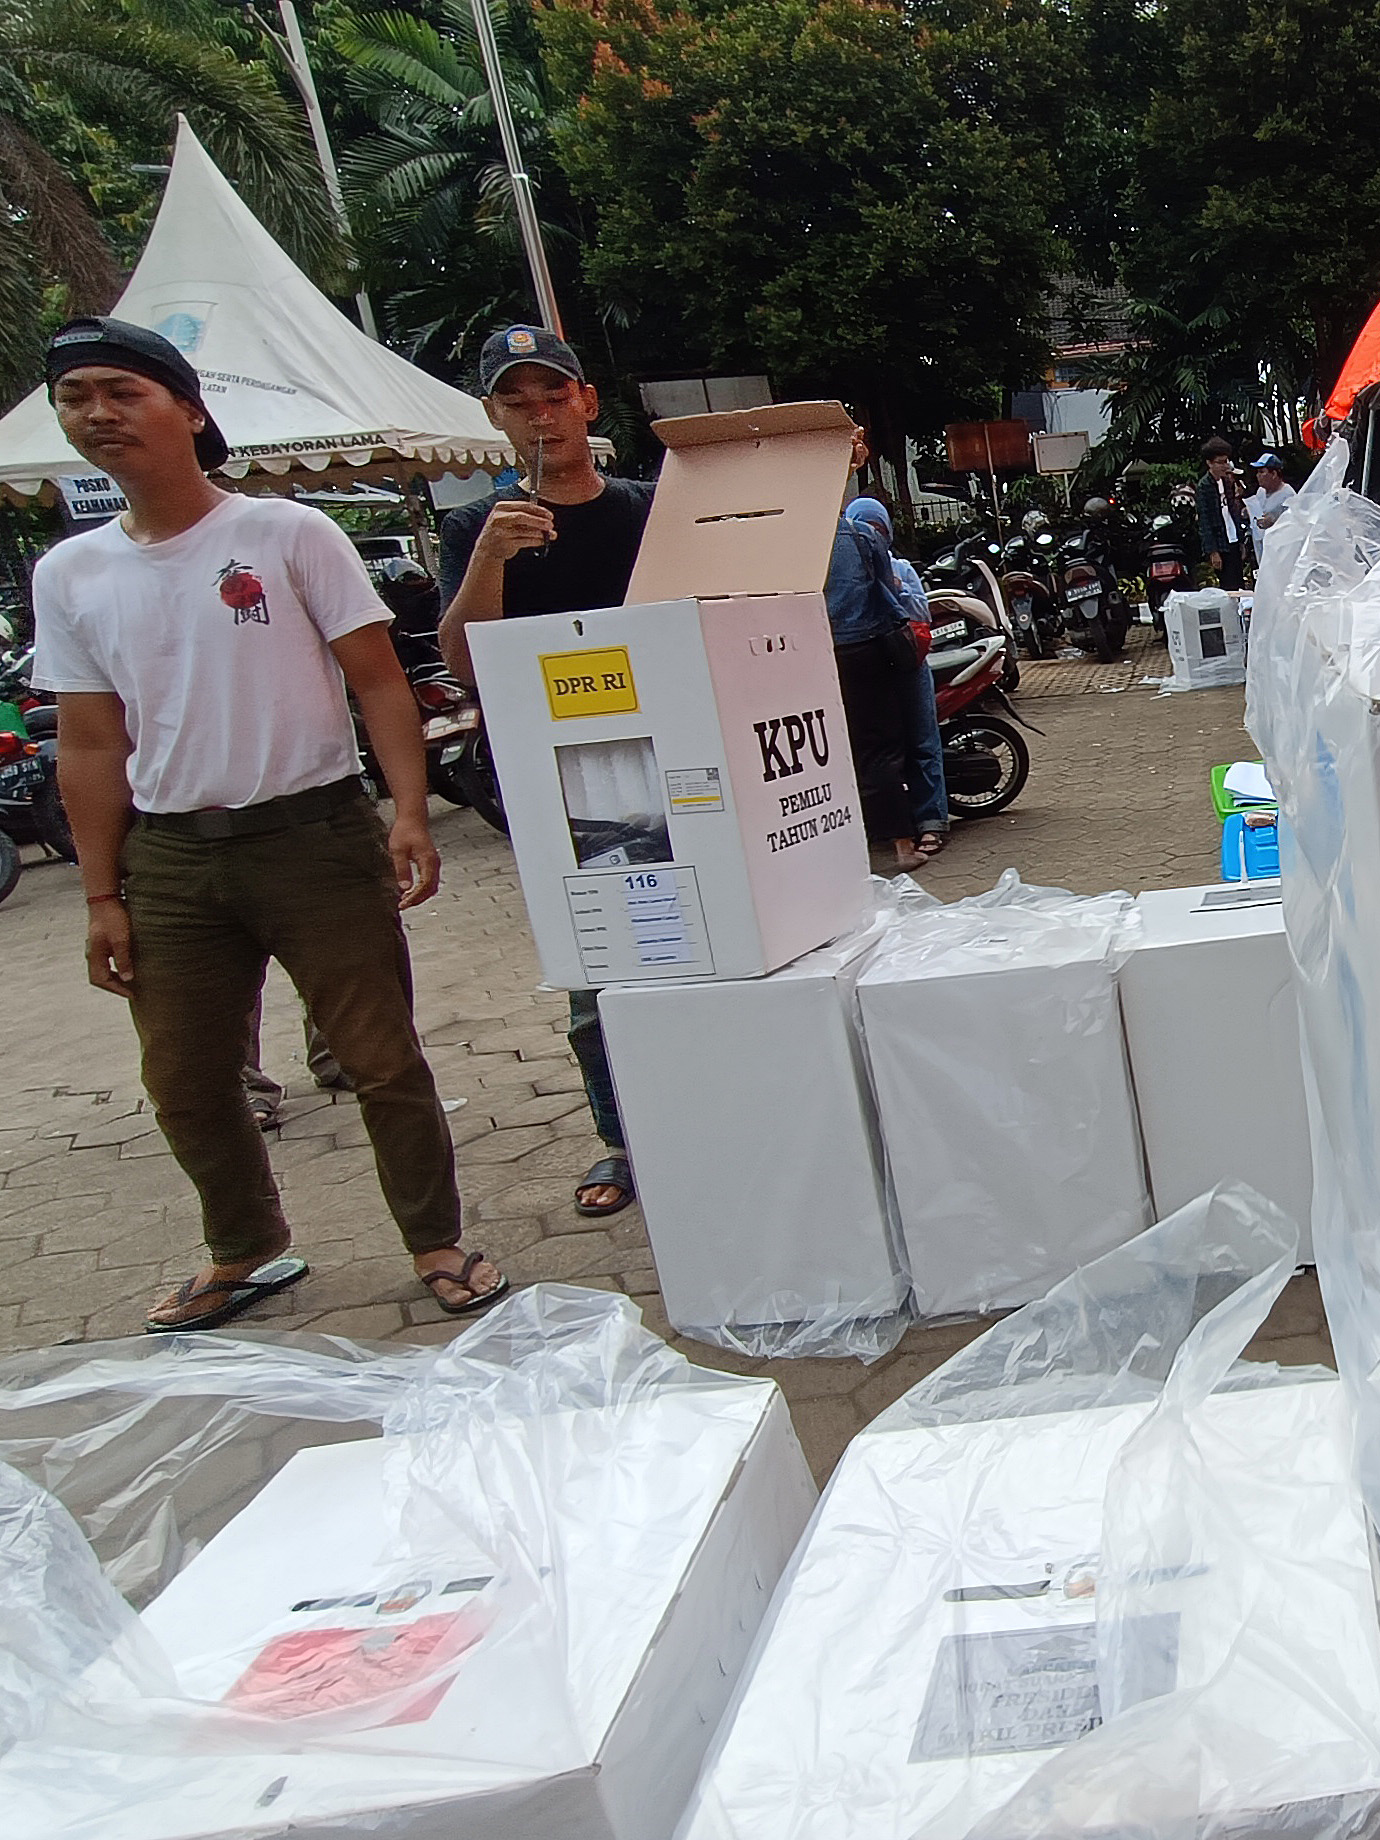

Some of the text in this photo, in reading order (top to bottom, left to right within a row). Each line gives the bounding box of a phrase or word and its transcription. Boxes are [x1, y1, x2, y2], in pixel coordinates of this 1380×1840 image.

[240, 438, 338, 457] KEBAYORAN
[340, 434, 387, 448] LAMA
[74, 477, 112, 494] POSKO
[553, 672, 627, 696] DPR RI
[753, 709, 829, 783] KPU
[779, 783, 832, 817] PEMILU
[766, 806, 851, 853] TAHUN 2024
[625, 874, 658, 890] 116
